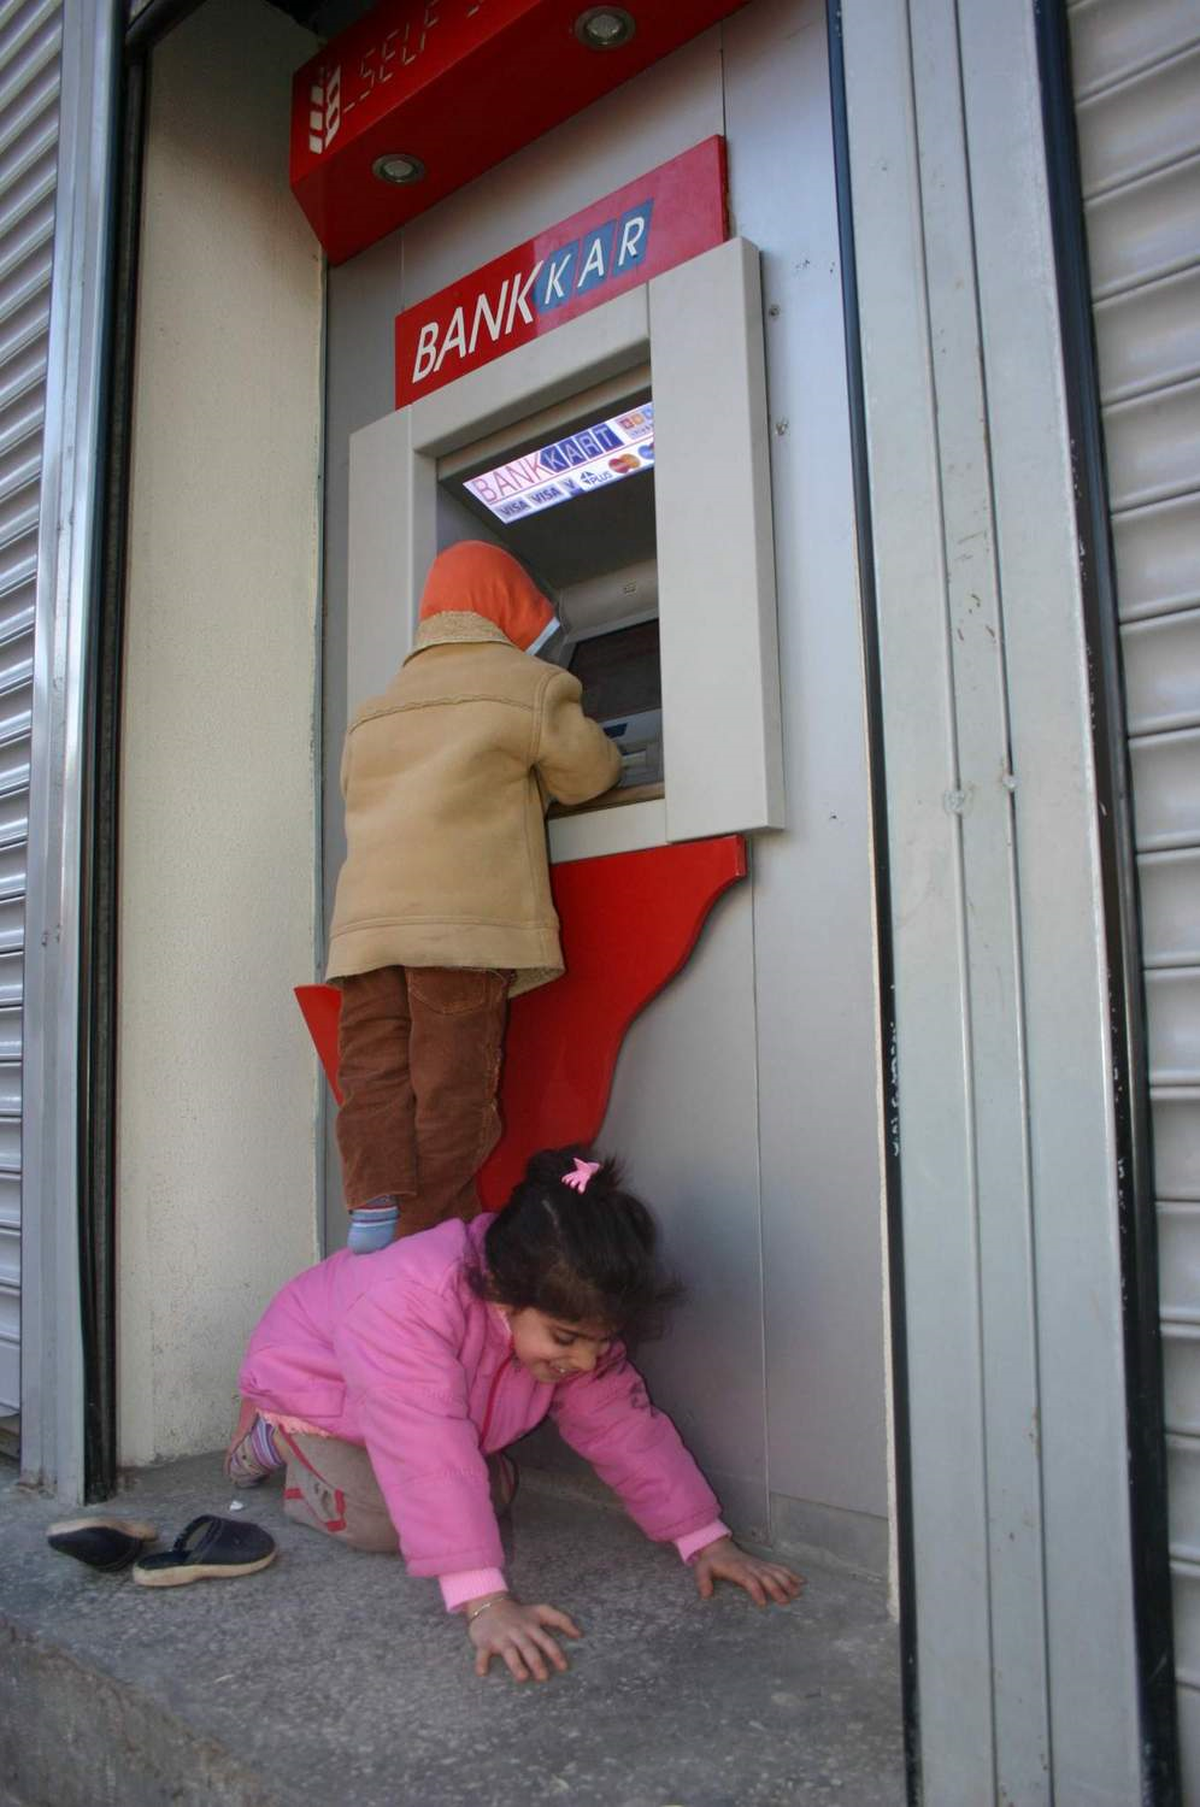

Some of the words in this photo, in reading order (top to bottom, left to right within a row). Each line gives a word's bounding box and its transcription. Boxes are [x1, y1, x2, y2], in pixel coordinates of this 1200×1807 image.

[500, 500, 529, 517] VISA
[531, 488, 561, 504] VISA
[590, 471, 613, 484] PLUS
